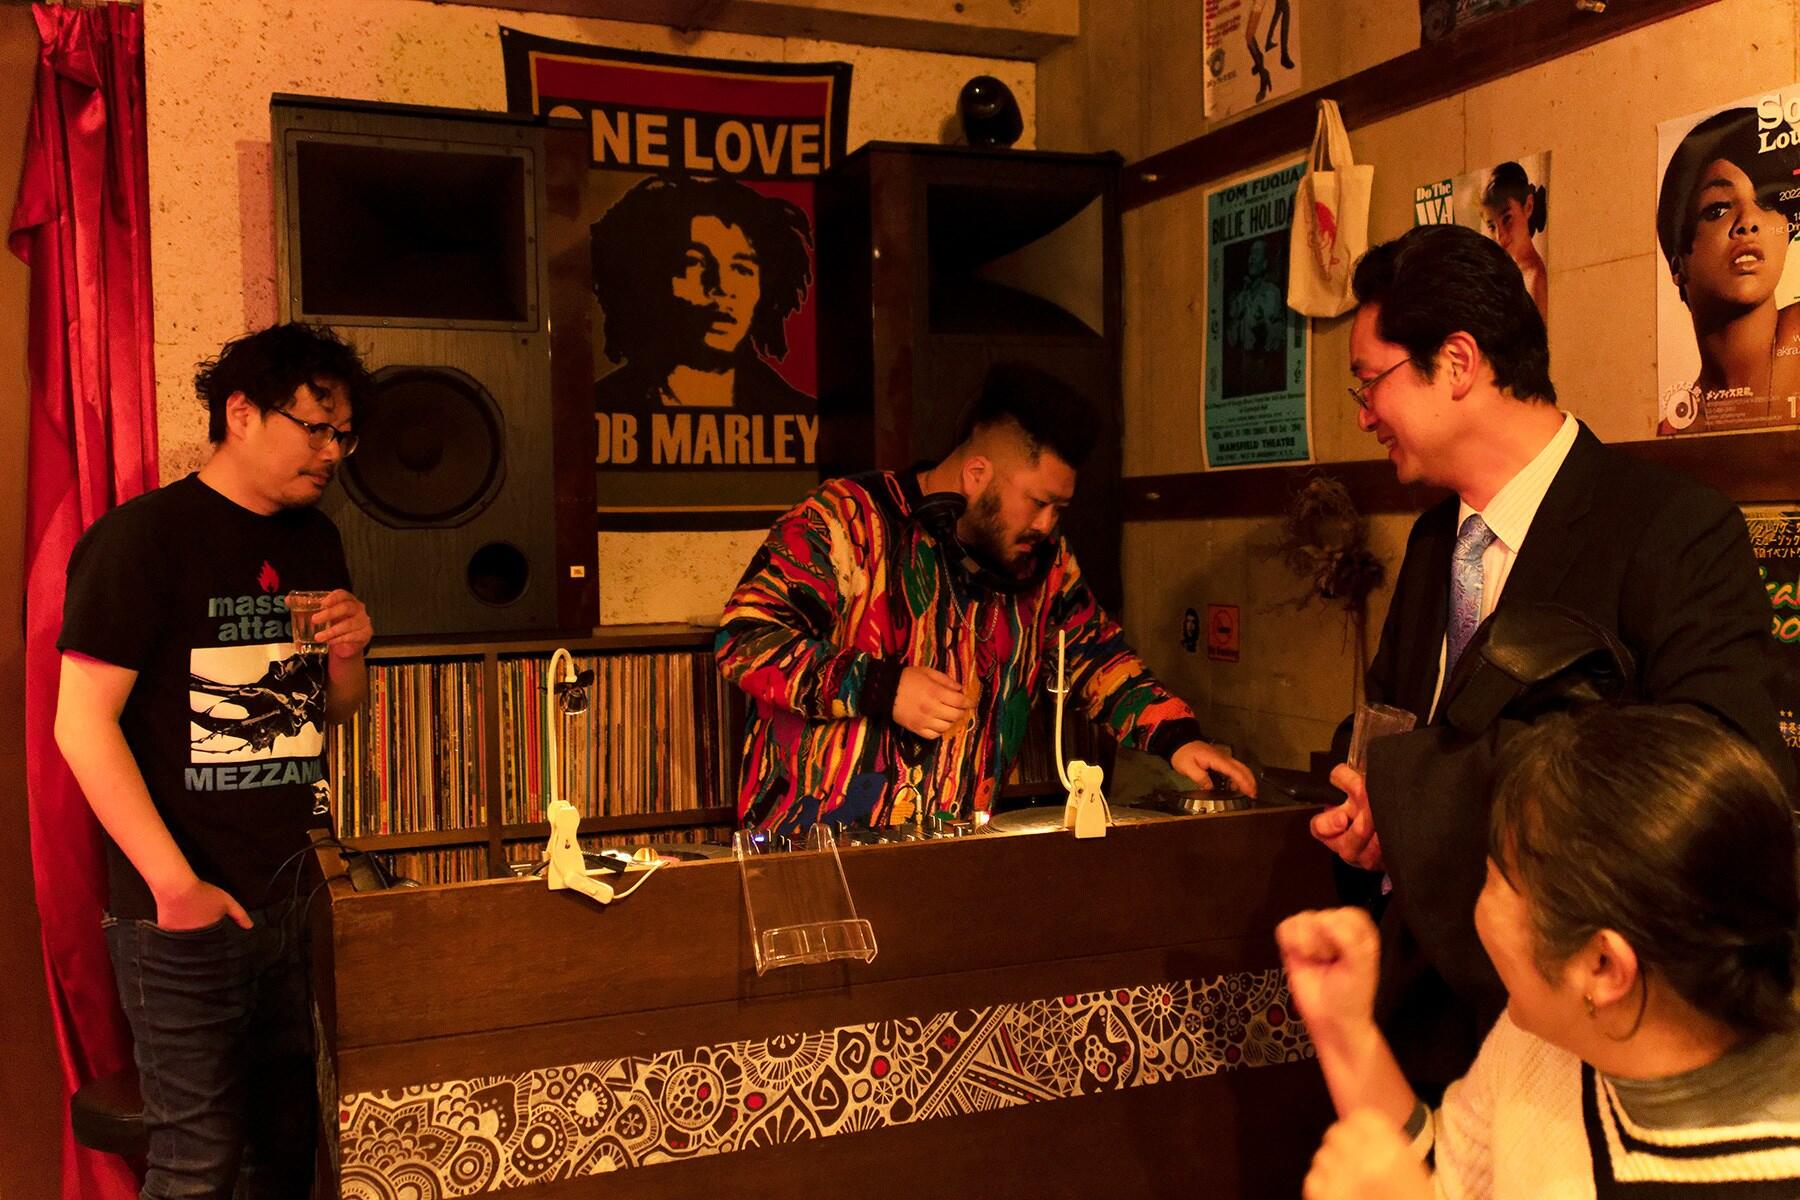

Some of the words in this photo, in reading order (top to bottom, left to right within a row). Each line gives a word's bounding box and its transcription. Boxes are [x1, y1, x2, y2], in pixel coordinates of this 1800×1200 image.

[549, 105, 669, 167] NE
[684, 117, 820, 174] LOVE
[1217, 185, 1248, 206] TOM
[1252, 168, 1300, 195] FUQUA
[1416, 187, 1432, 202] Do
[1431, 183, 1451, 197] The
[1213, 210, 1245, 245] BILLIE
[595, 412, 638, 464] OB
[652, 413, 819, 465] MARLEY
